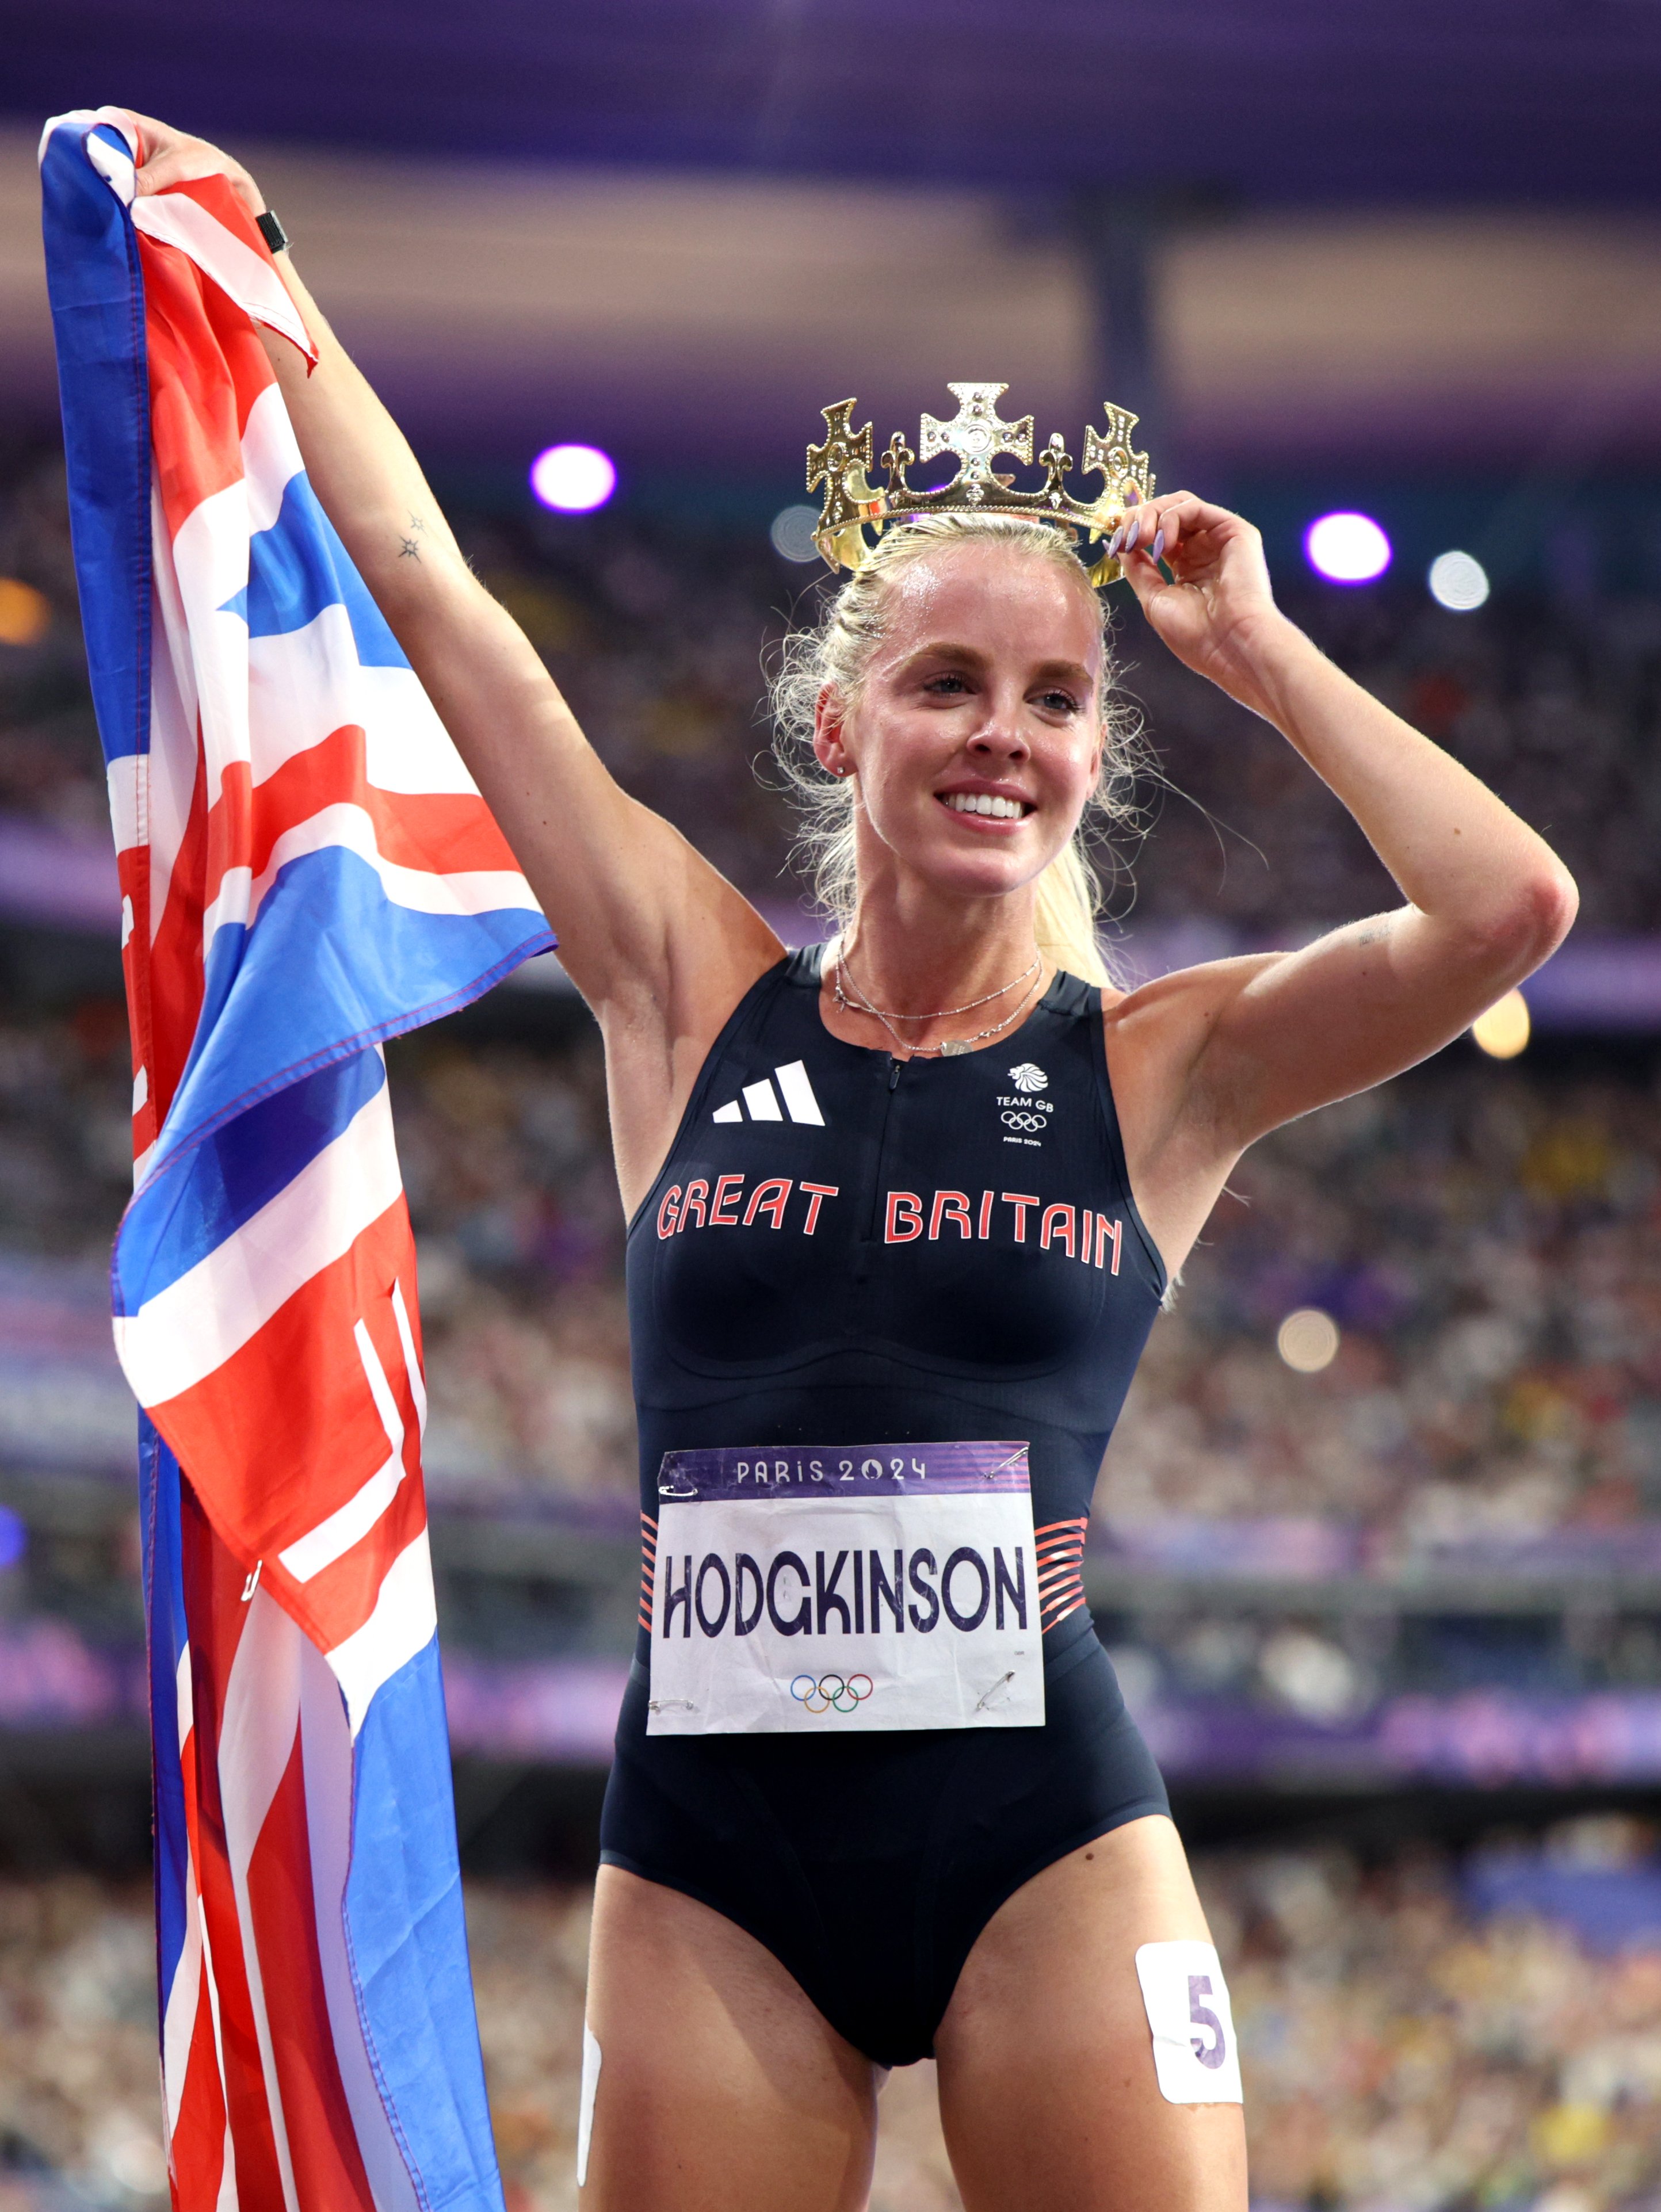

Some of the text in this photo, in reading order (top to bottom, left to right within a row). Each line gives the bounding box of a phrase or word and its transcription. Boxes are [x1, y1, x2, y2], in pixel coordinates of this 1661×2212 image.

[996, 1097, 1054, 1113] TEAM GB
[1024, 1139, 1041, 1147] 2024
[656, 1174, 1122, 1276] GREAT BRITAIN
[839, 1458, 926, 1481] 2024
[662, 1546, 1028, 1638] HODGKINSON
[1187, 1975, 1225, 2069] 5
